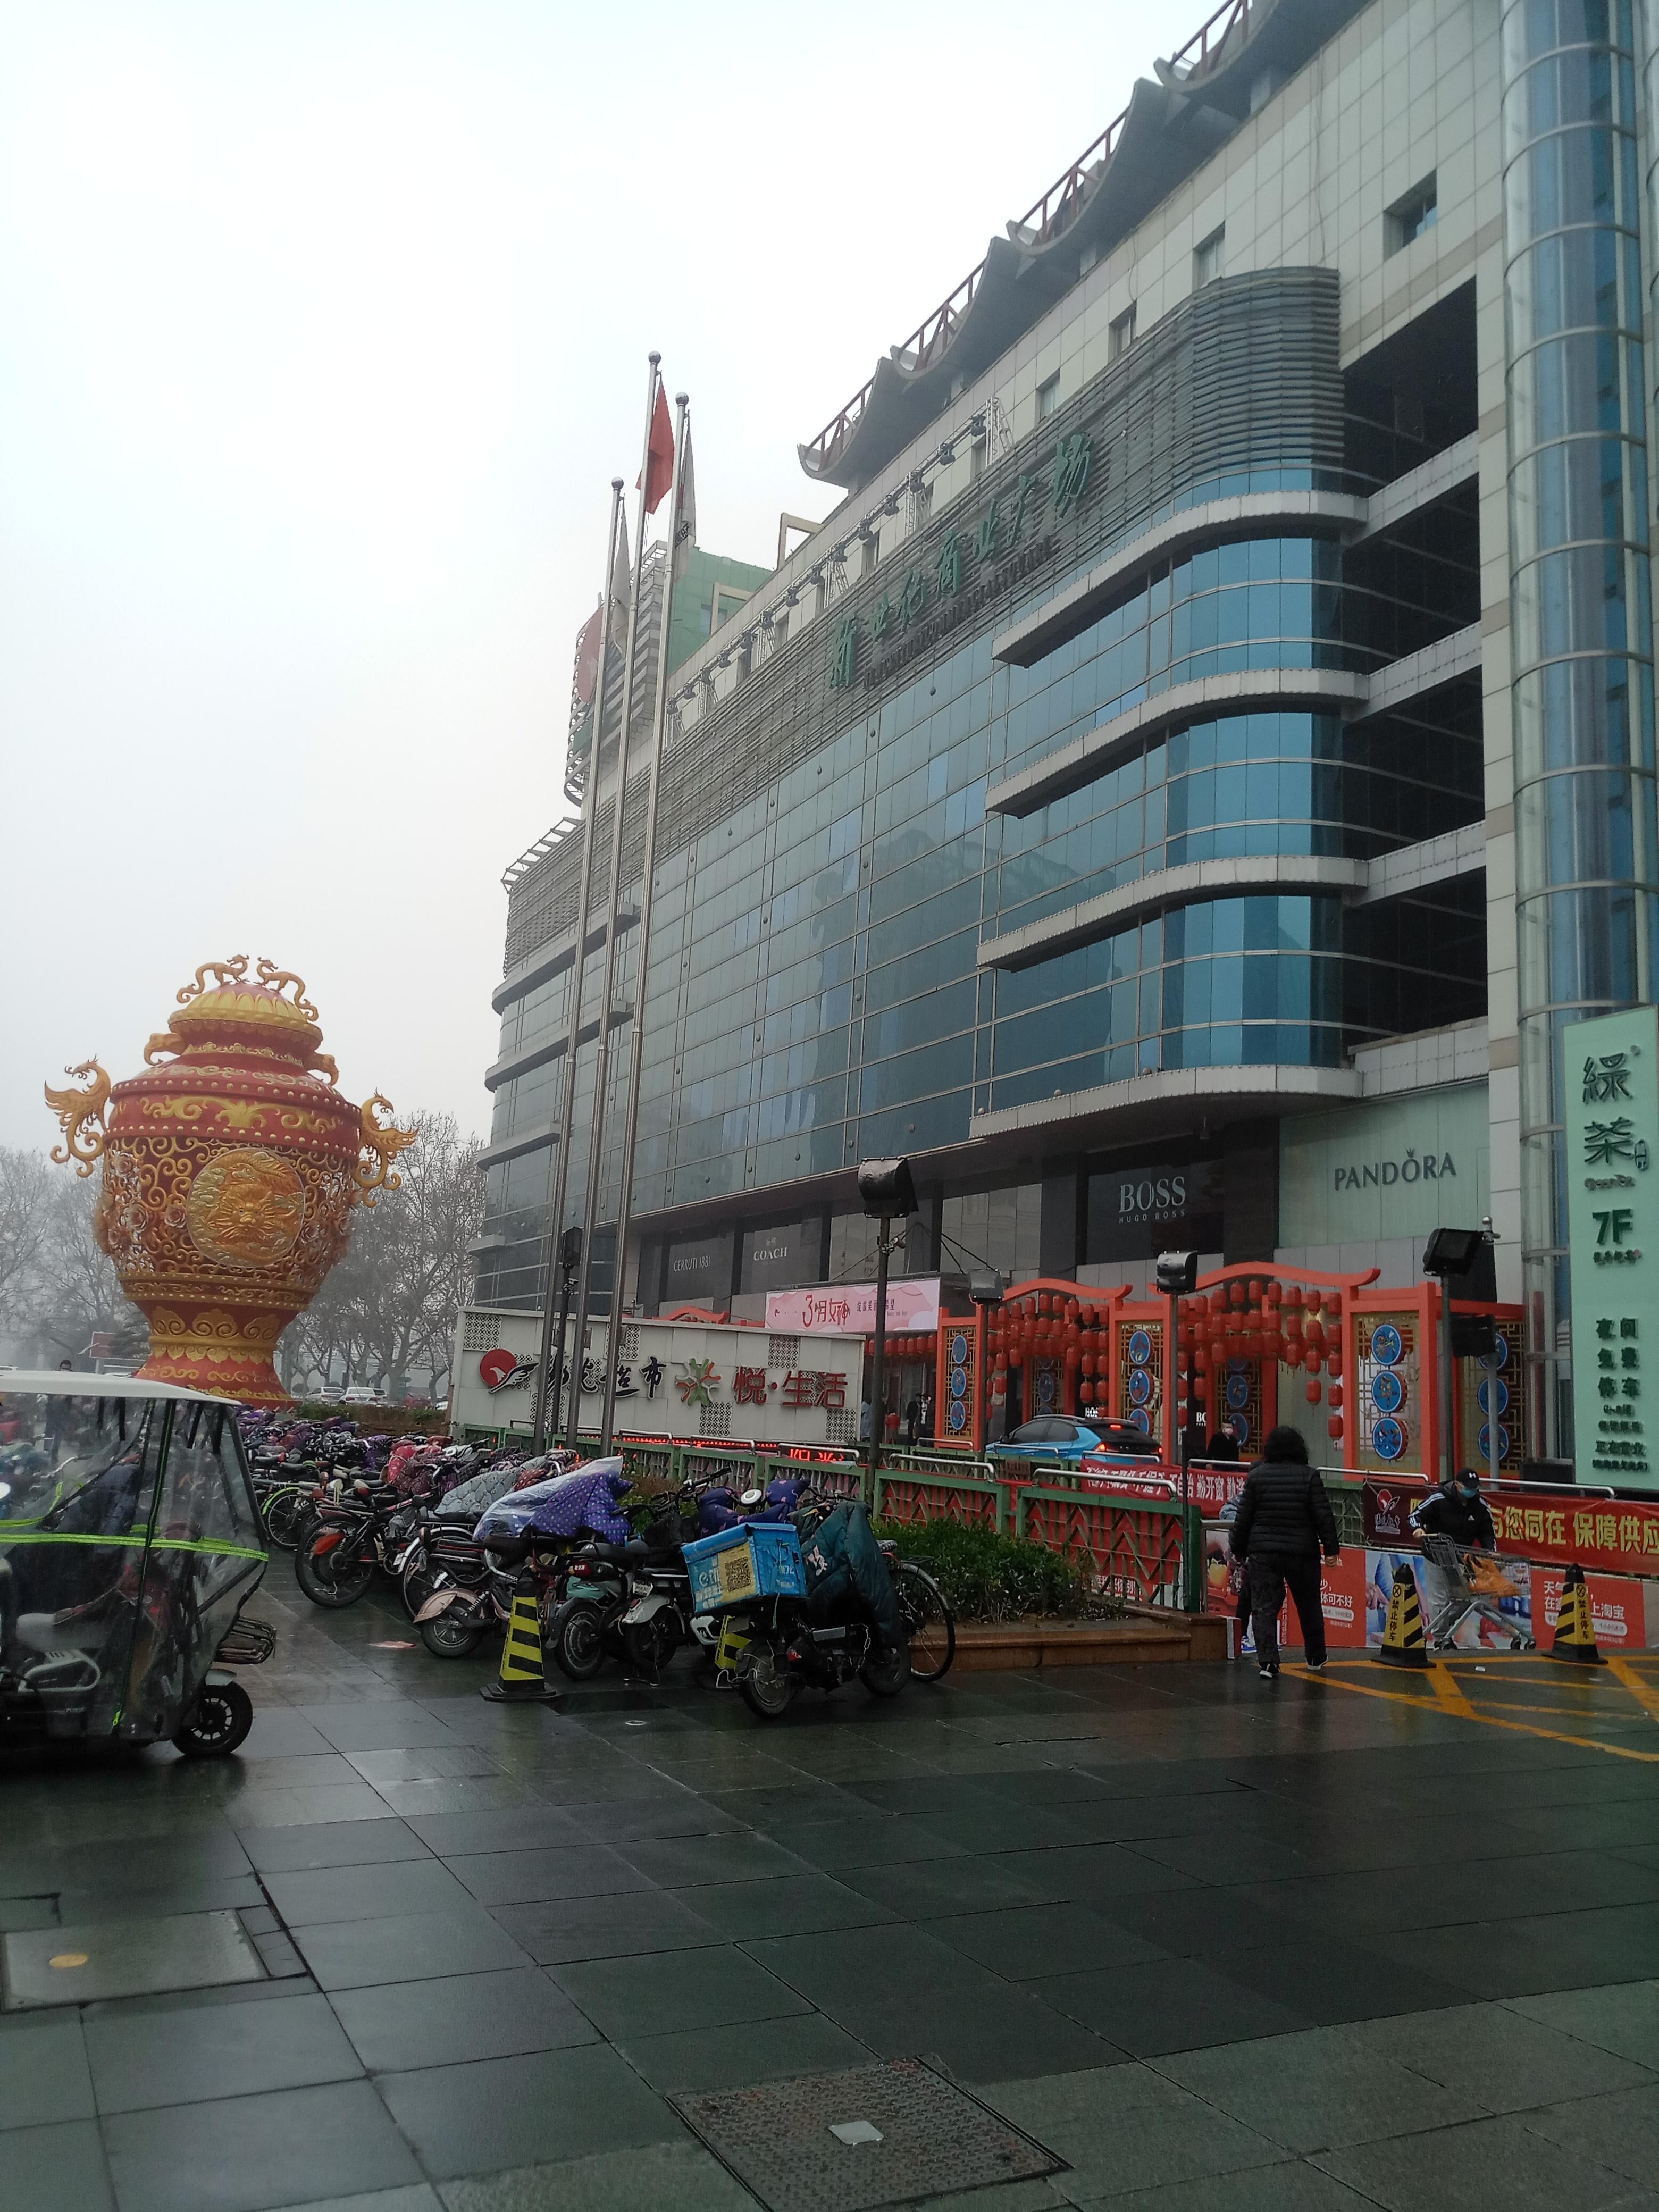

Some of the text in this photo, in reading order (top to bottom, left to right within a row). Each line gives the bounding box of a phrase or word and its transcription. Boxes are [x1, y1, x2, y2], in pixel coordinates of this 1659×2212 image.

[1334, 1151, 1456, 1191] PANDORA
[1118, 1176, 1186, 1213] BOSS
[1119, 1208, 1186, 1224] HUGO BOSS
[1592, 1209, 1633, 1244] 7F
[674, 1255, 710, 1272] CERRUTI 1881
[753, 1247, 787, 1261] COACH
[1573, 1511, 1659, 1555] 保障供应
[1389, 1599, 1400, 1641] 禁止停车
